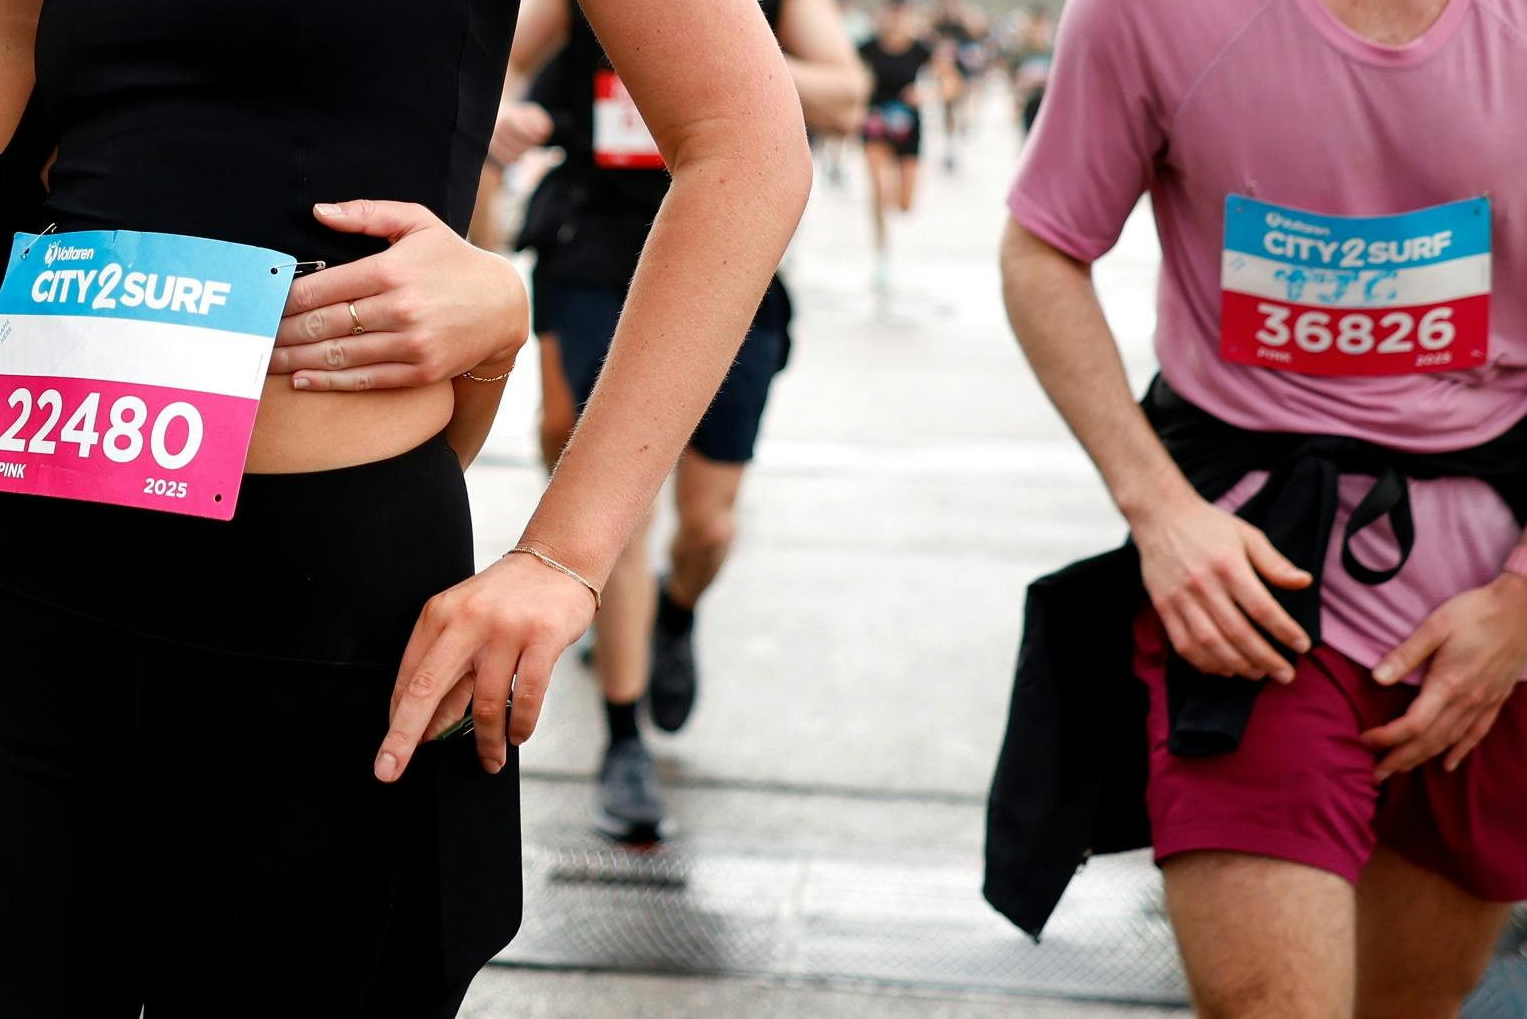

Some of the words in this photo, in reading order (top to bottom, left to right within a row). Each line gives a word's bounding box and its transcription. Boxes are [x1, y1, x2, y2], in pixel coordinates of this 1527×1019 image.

[57, 245, 95, 262] Voltaren
[1255, 302, 1456, 355] 36826
[143, 477, 188, 498] 2025
